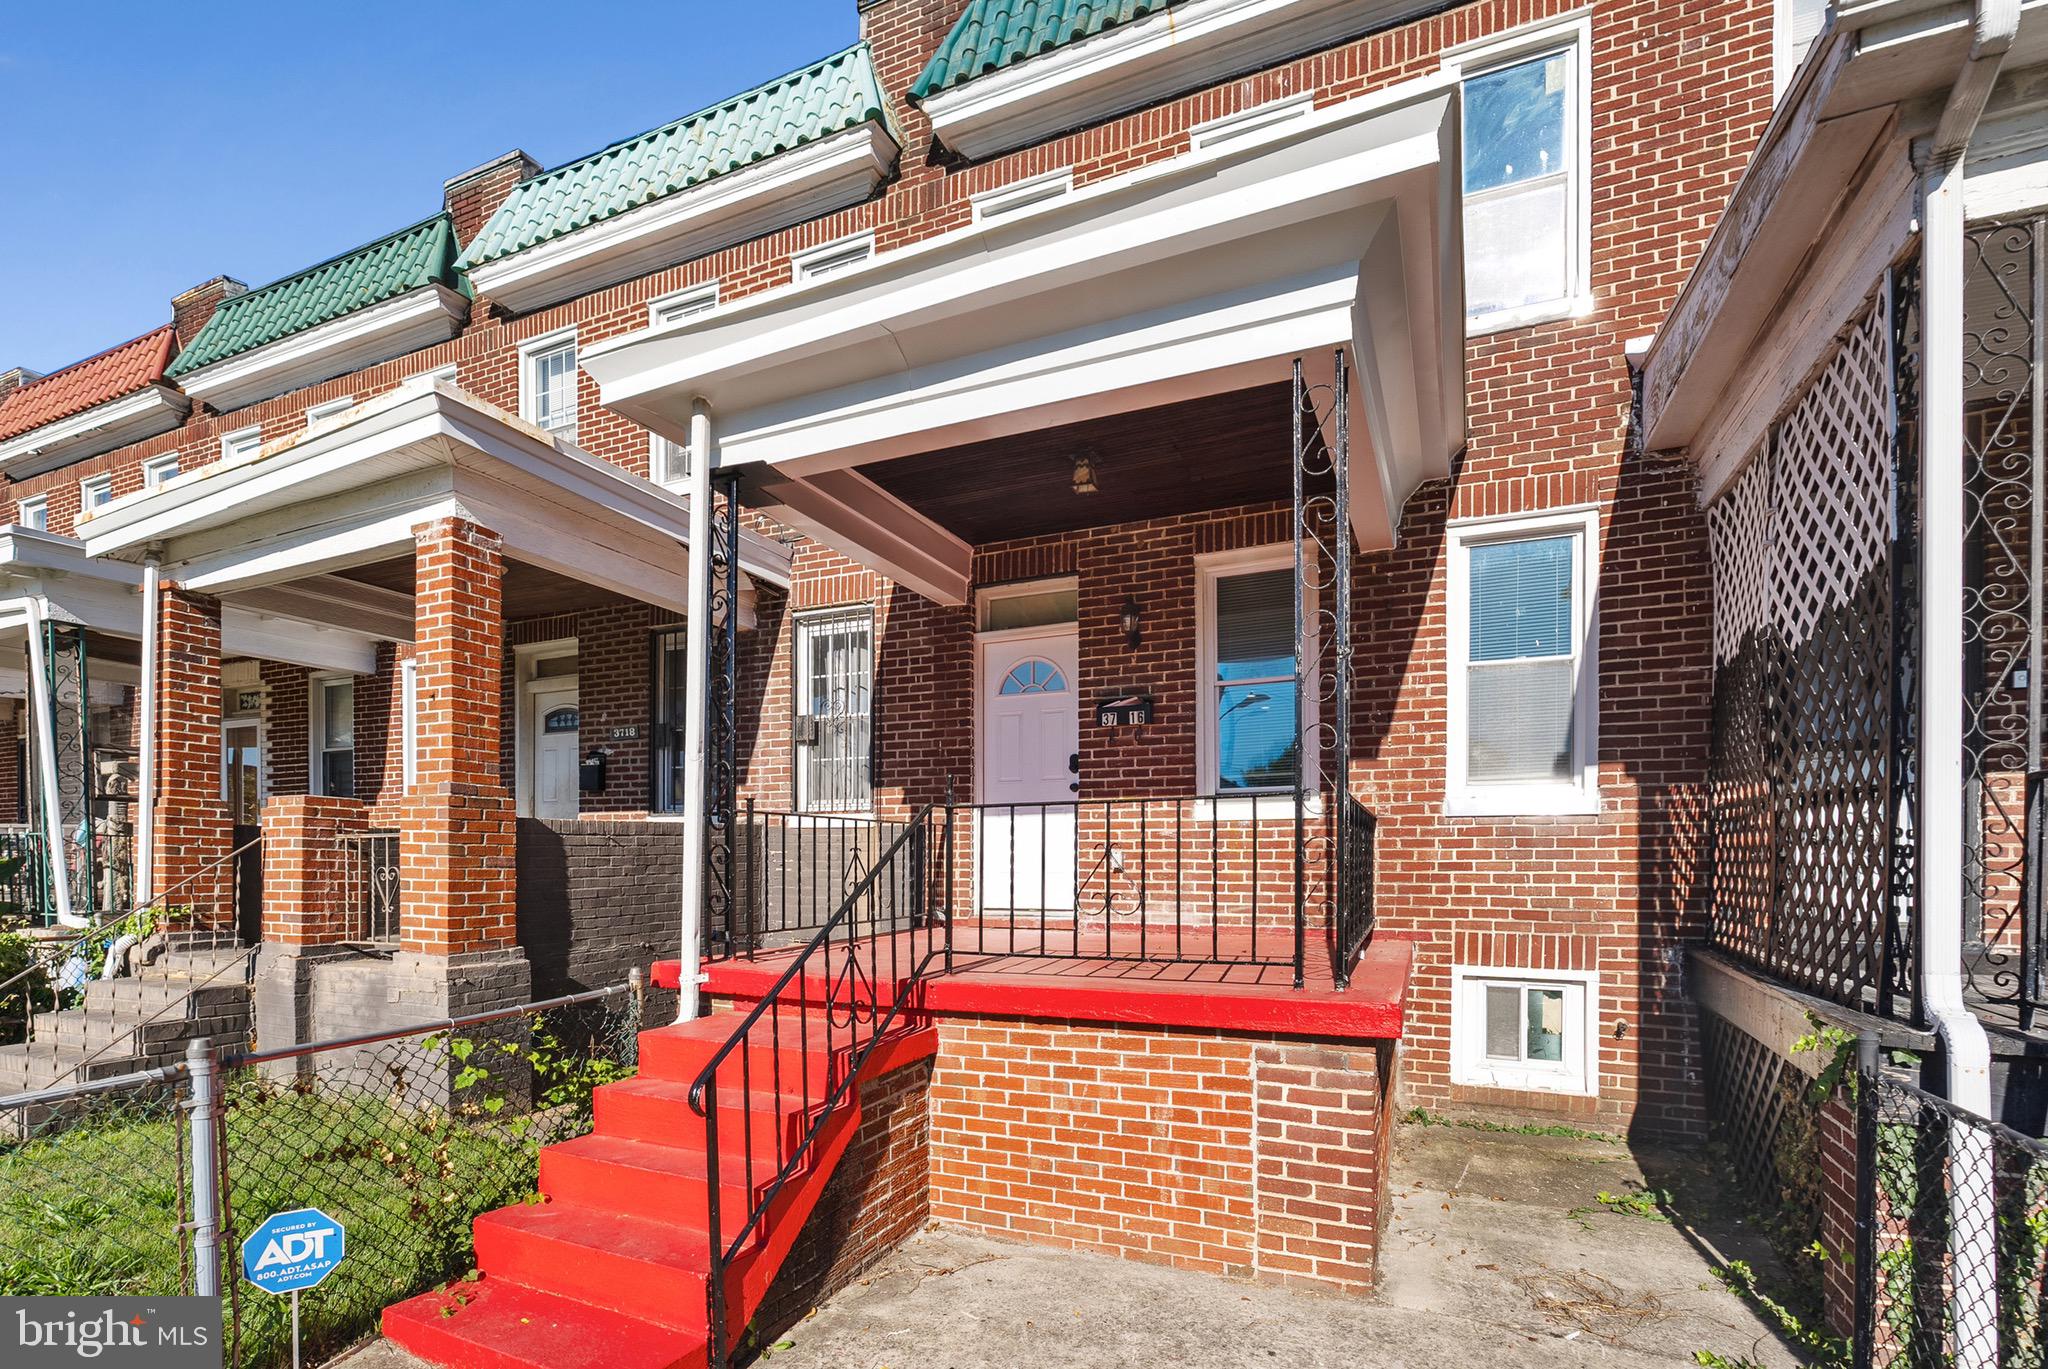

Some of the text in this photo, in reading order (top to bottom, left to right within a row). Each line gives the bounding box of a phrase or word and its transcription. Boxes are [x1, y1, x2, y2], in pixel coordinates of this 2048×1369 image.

[1103, 711, 1144, 726] 37 16
[613, 727, 636, 738] 3718
[272, 1223, 305, 1234] SECURED
[253, 1228, 334, 1272] ADT
[256, 1260, 332, 1281] 800.ADT.ASAP
[277, 1272, 313, 1284] ADT.COM
